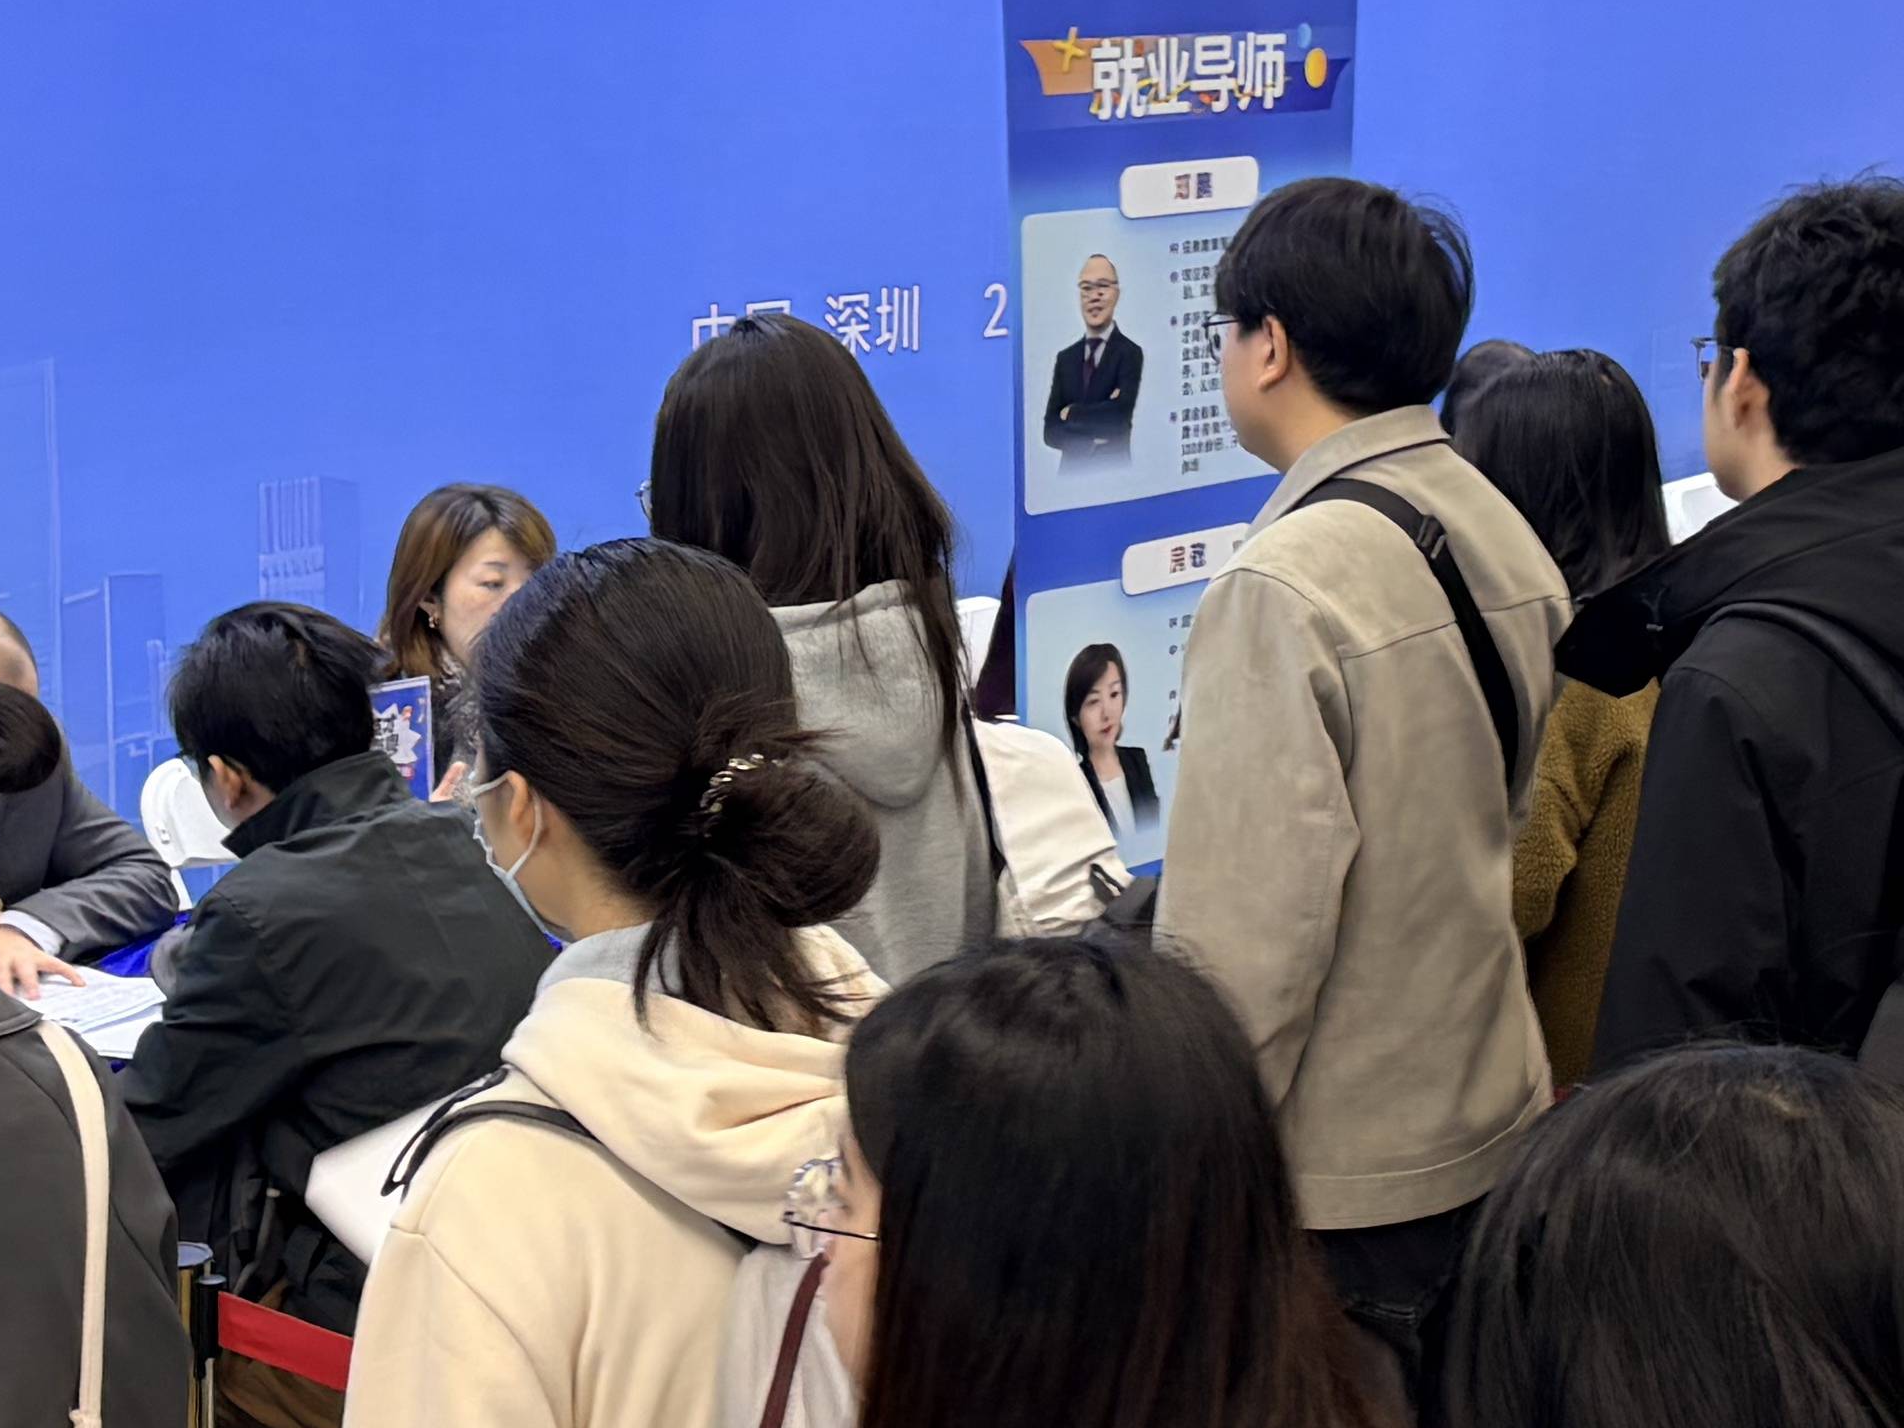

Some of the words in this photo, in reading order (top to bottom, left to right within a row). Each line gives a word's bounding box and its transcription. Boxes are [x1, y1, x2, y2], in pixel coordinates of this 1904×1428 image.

[1088, 31, 1288, 121] 就业导师
[824, 284, 920, 355] 深圳
